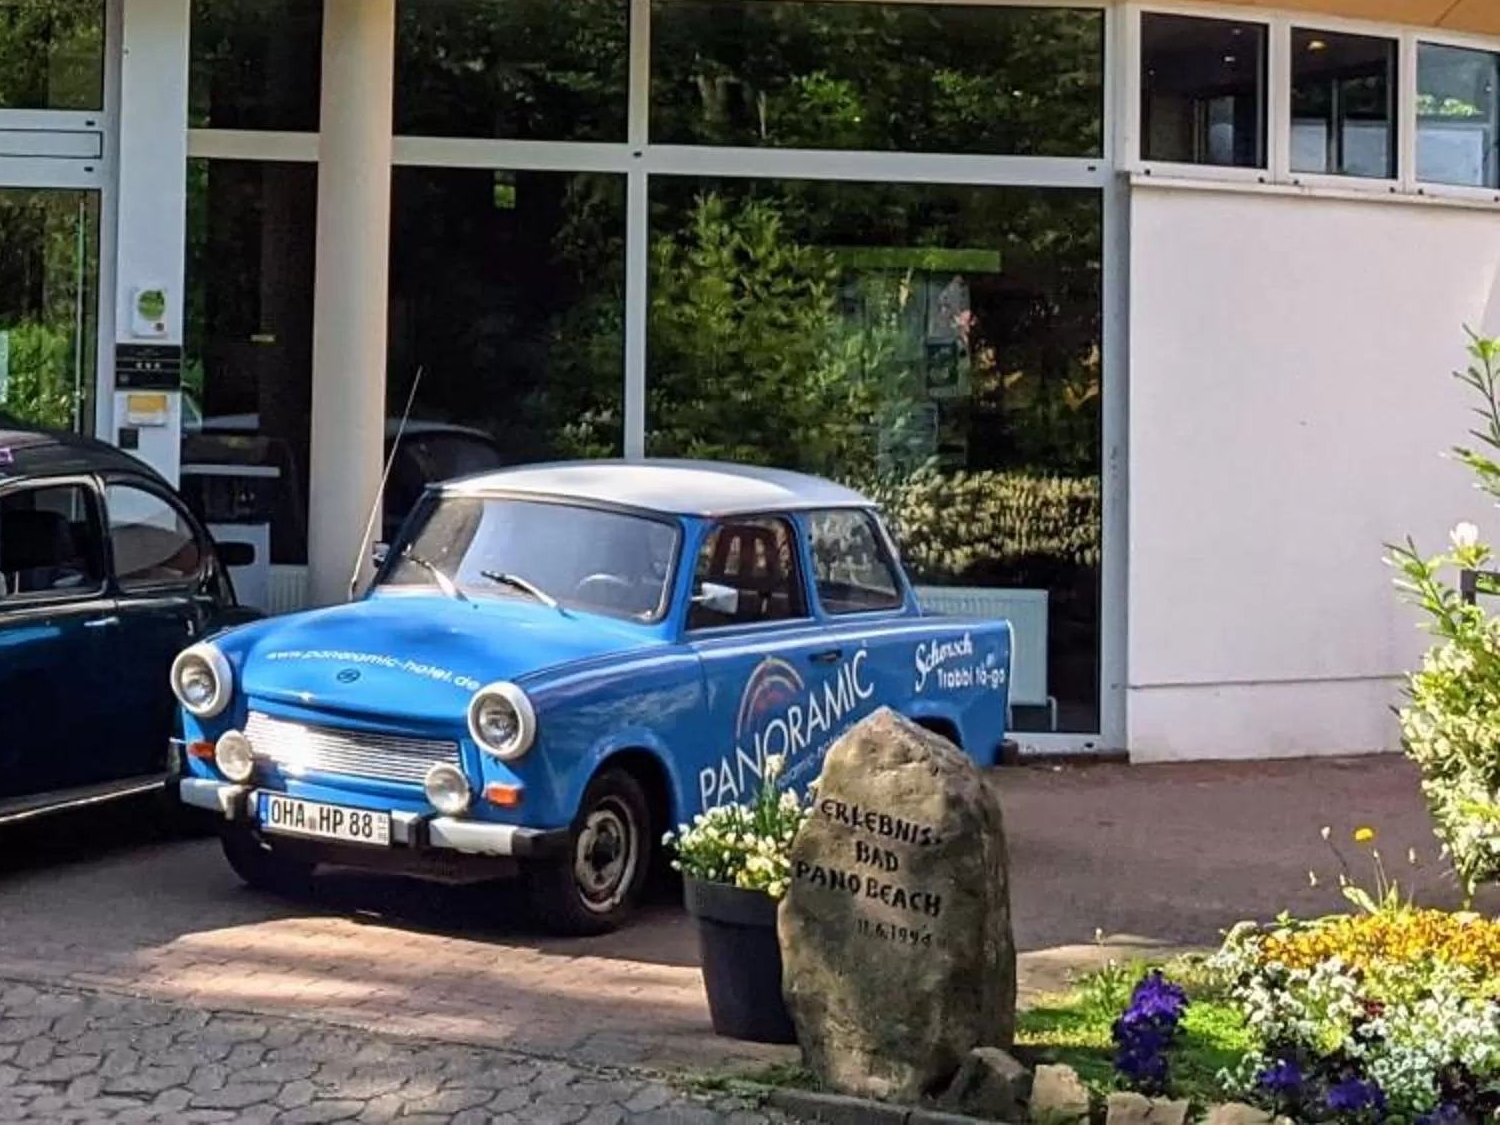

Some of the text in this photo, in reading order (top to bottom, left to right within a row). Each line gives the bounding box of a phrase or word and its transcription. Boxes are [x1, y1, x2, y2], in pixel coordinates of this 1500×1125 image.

[700, 649, 874, 813] PANORAMIC
[271, 799, 305, 828] OHA
[319, 807, 343, 834] HP
[350, 812, 373, 838] 88
[855, 841, 898, 872] BAD
